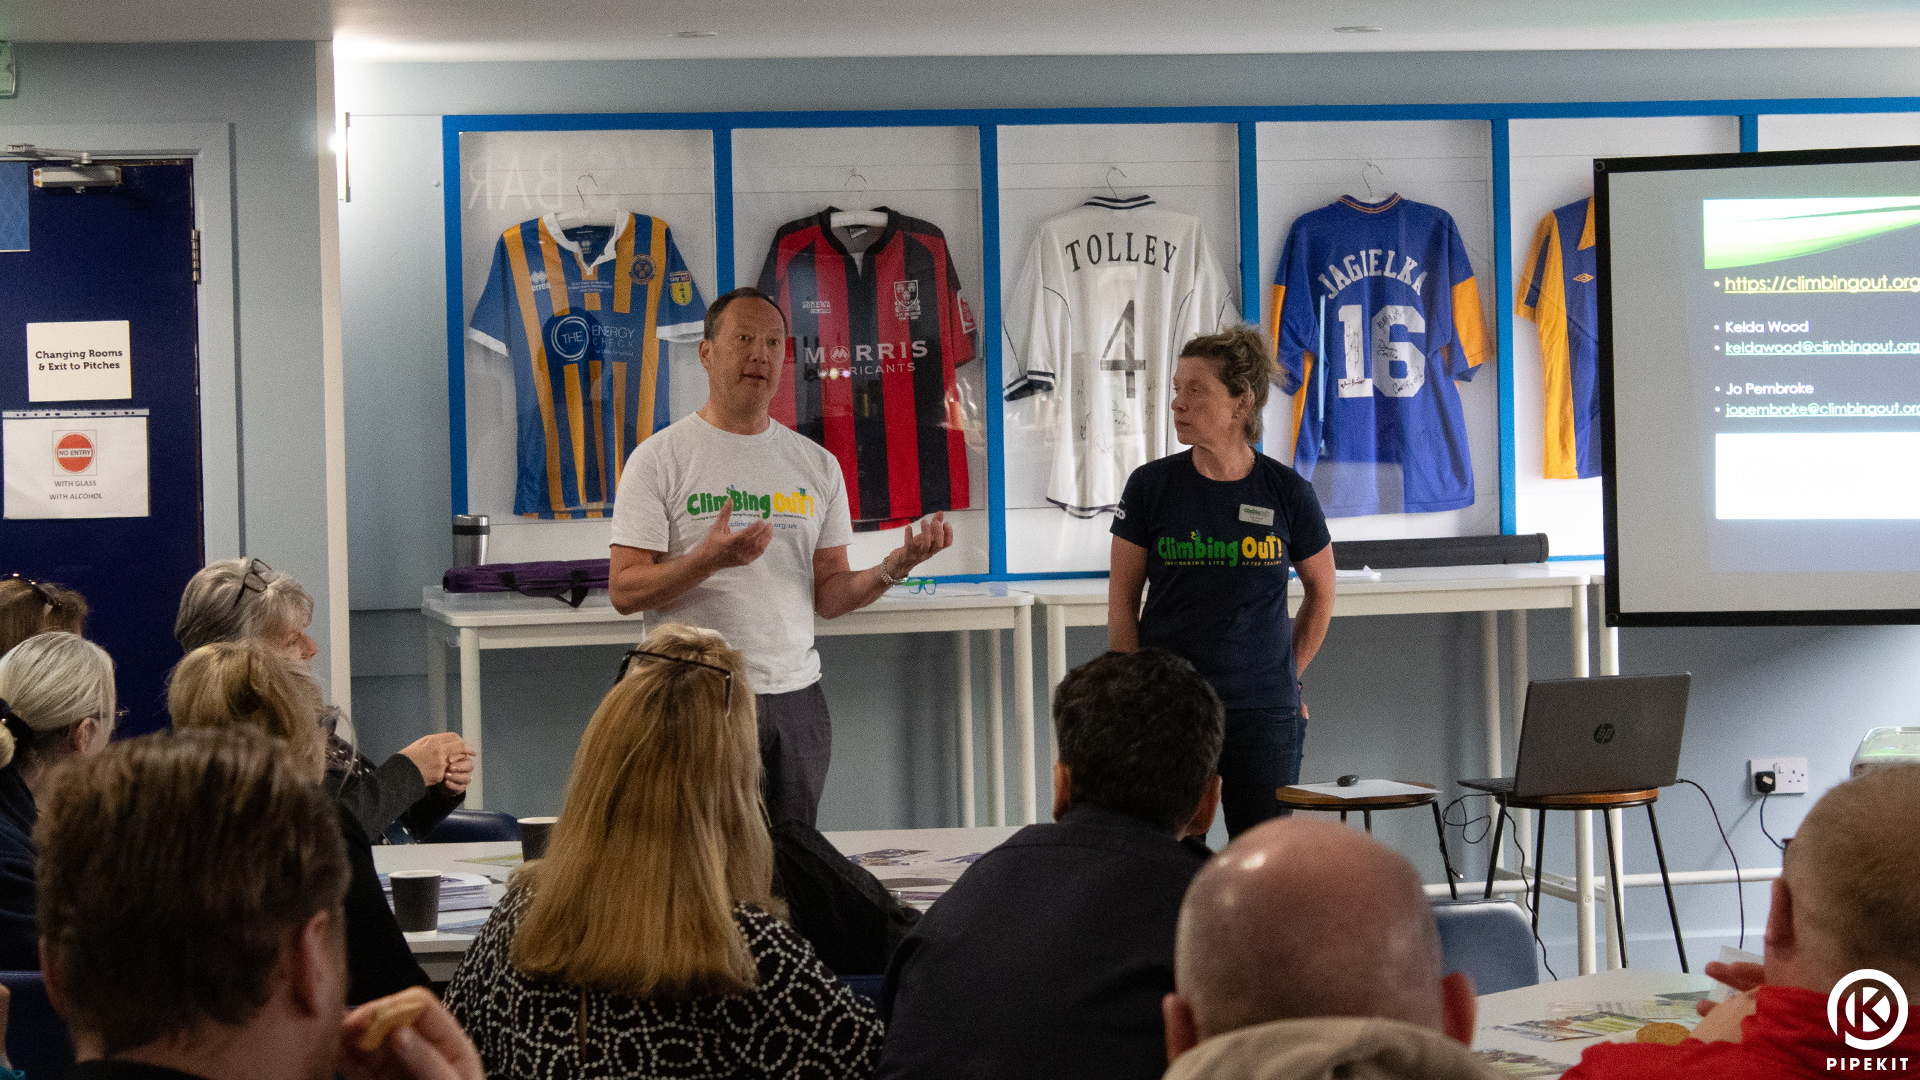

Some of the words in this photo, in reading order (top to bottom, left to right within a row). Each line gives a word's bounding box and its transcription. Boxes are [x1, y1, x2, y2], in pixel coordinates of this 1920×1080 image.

[1065, 232, 1177, 273] TOLLEY
[1318, 249, 1428, 300] JAGIELKA
[1725, 274, 1920, 293] https://climbingout.org
[591, 325, 635, 338] ENERGY
[1725, 321, 1765, 333] Kelda
[1768, 320, 1810, 333] Wood
[561, 331, 583, 343] THE
[592, 338, 634, 348] CHECK
[35, 351, 86, 360] Changing
[88, 349, 123, 358] Rooms
[1100, 300, 1146, 398] 4
[1338, 304, 1426, 398] 16
[1725, 339, 1920, 355] keldawood@climbingout.org
[38, 363, 45, 371] &
[48, 362, 68, 371] Exit
[69, 362, 81, 370] to
[82, 361, 120, 369] Pitches
[1726, 382, 1743, 395] Jo
[1745, 382, 1815, 395] Pembroke
[1157, 534, 1239, 567] Climbing
[1593, 723, 1615, 744] hp
